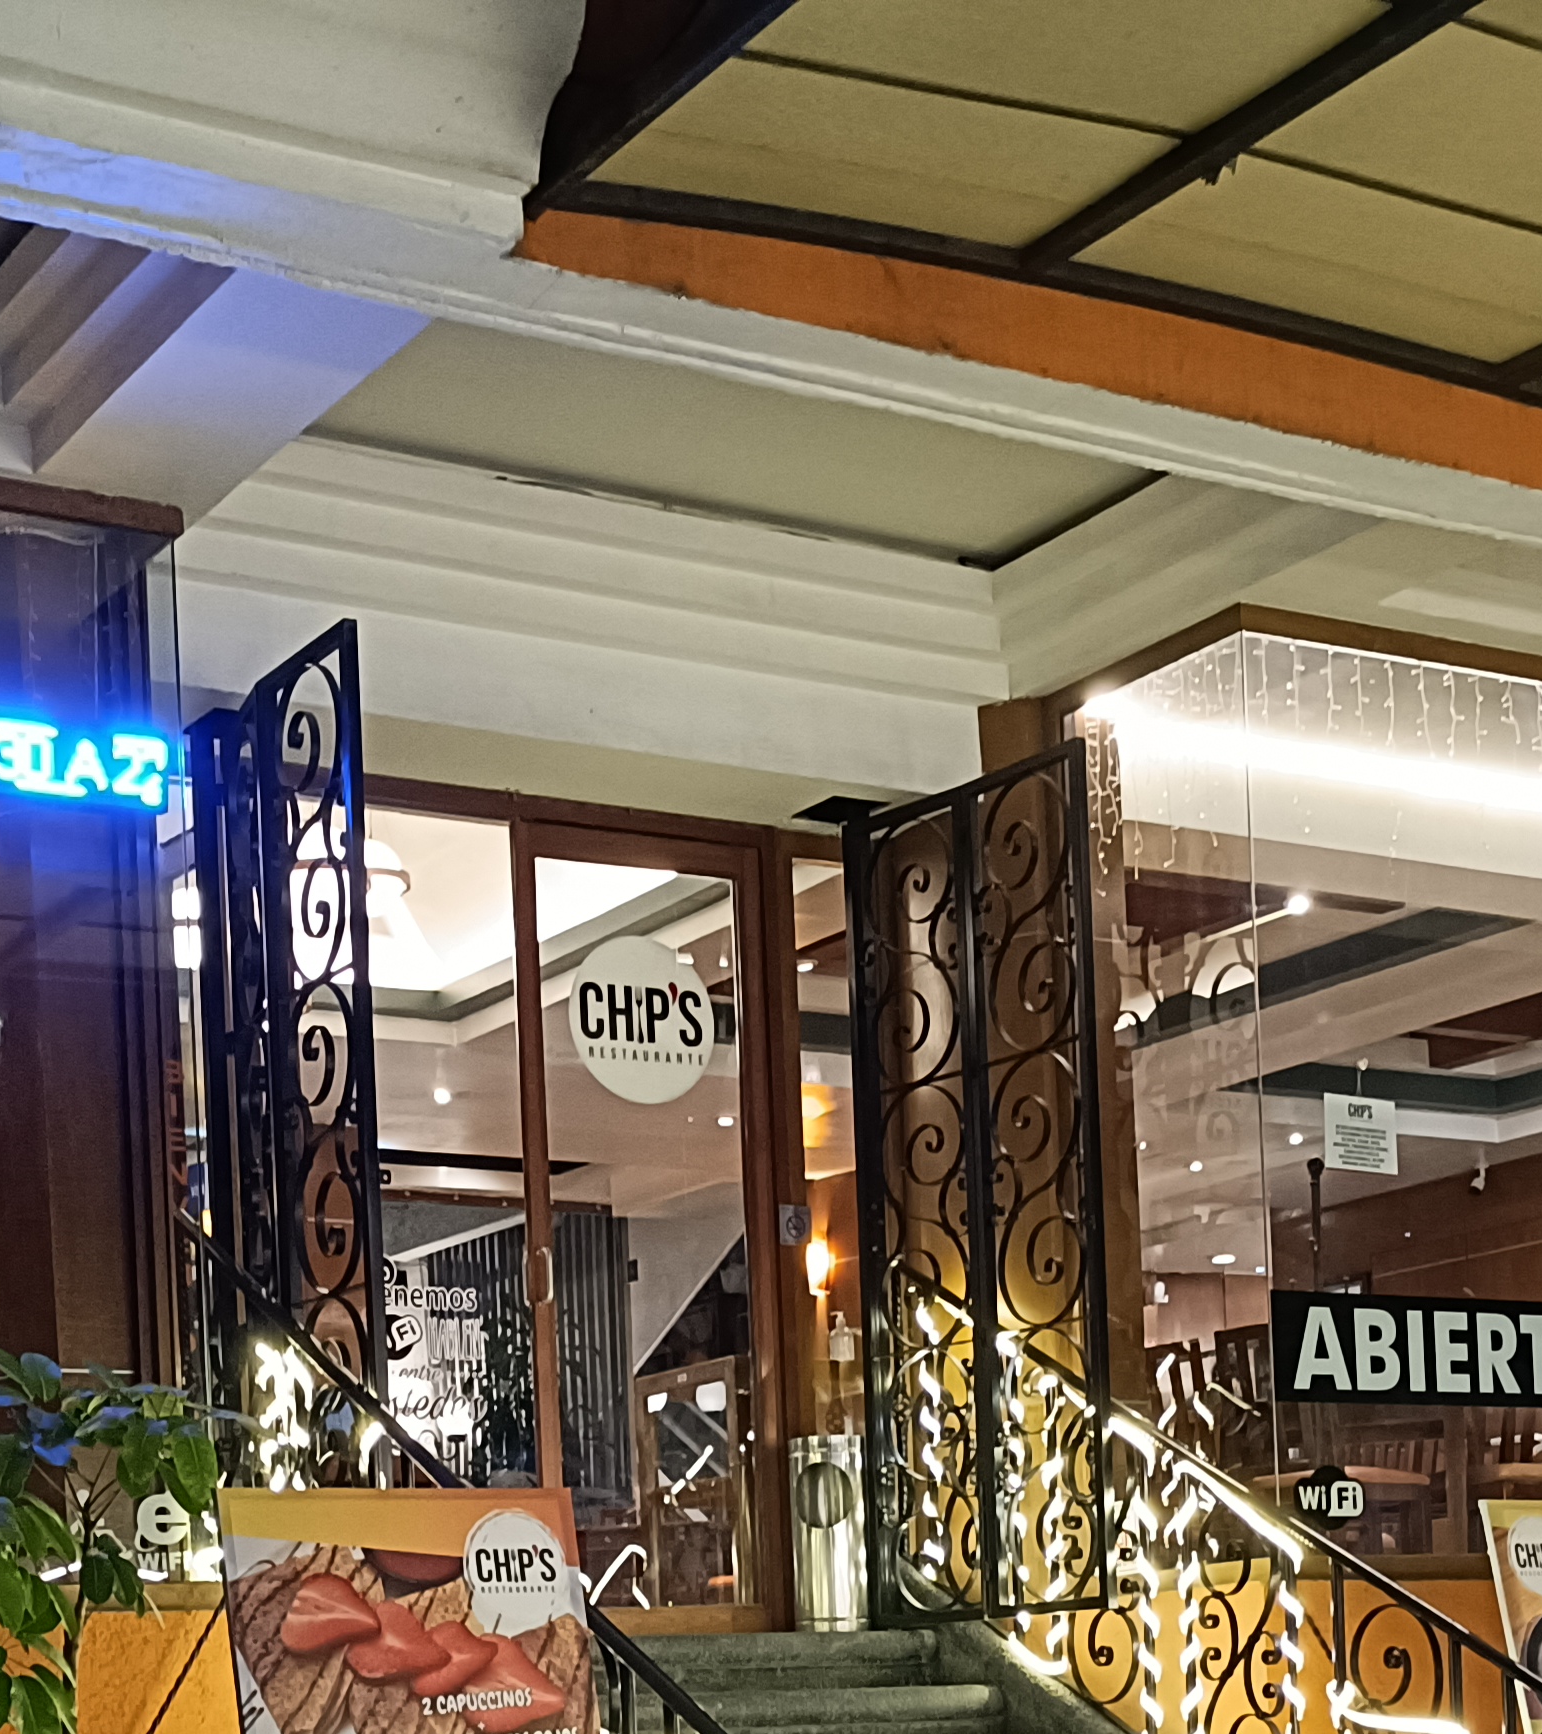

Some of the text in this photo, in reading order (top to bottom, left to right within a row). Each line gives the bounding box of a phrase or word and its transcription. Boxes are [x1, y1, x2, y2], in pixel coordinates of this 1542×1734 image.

[580, 982, 702, 1047] CHIP'S
[588, 1046, 703, 1066] RESTAURANTE
[475, 1544, 557, 1584] CHIP'S
[421, 1687, 533, 1716] 2 CAPUCCINOS
